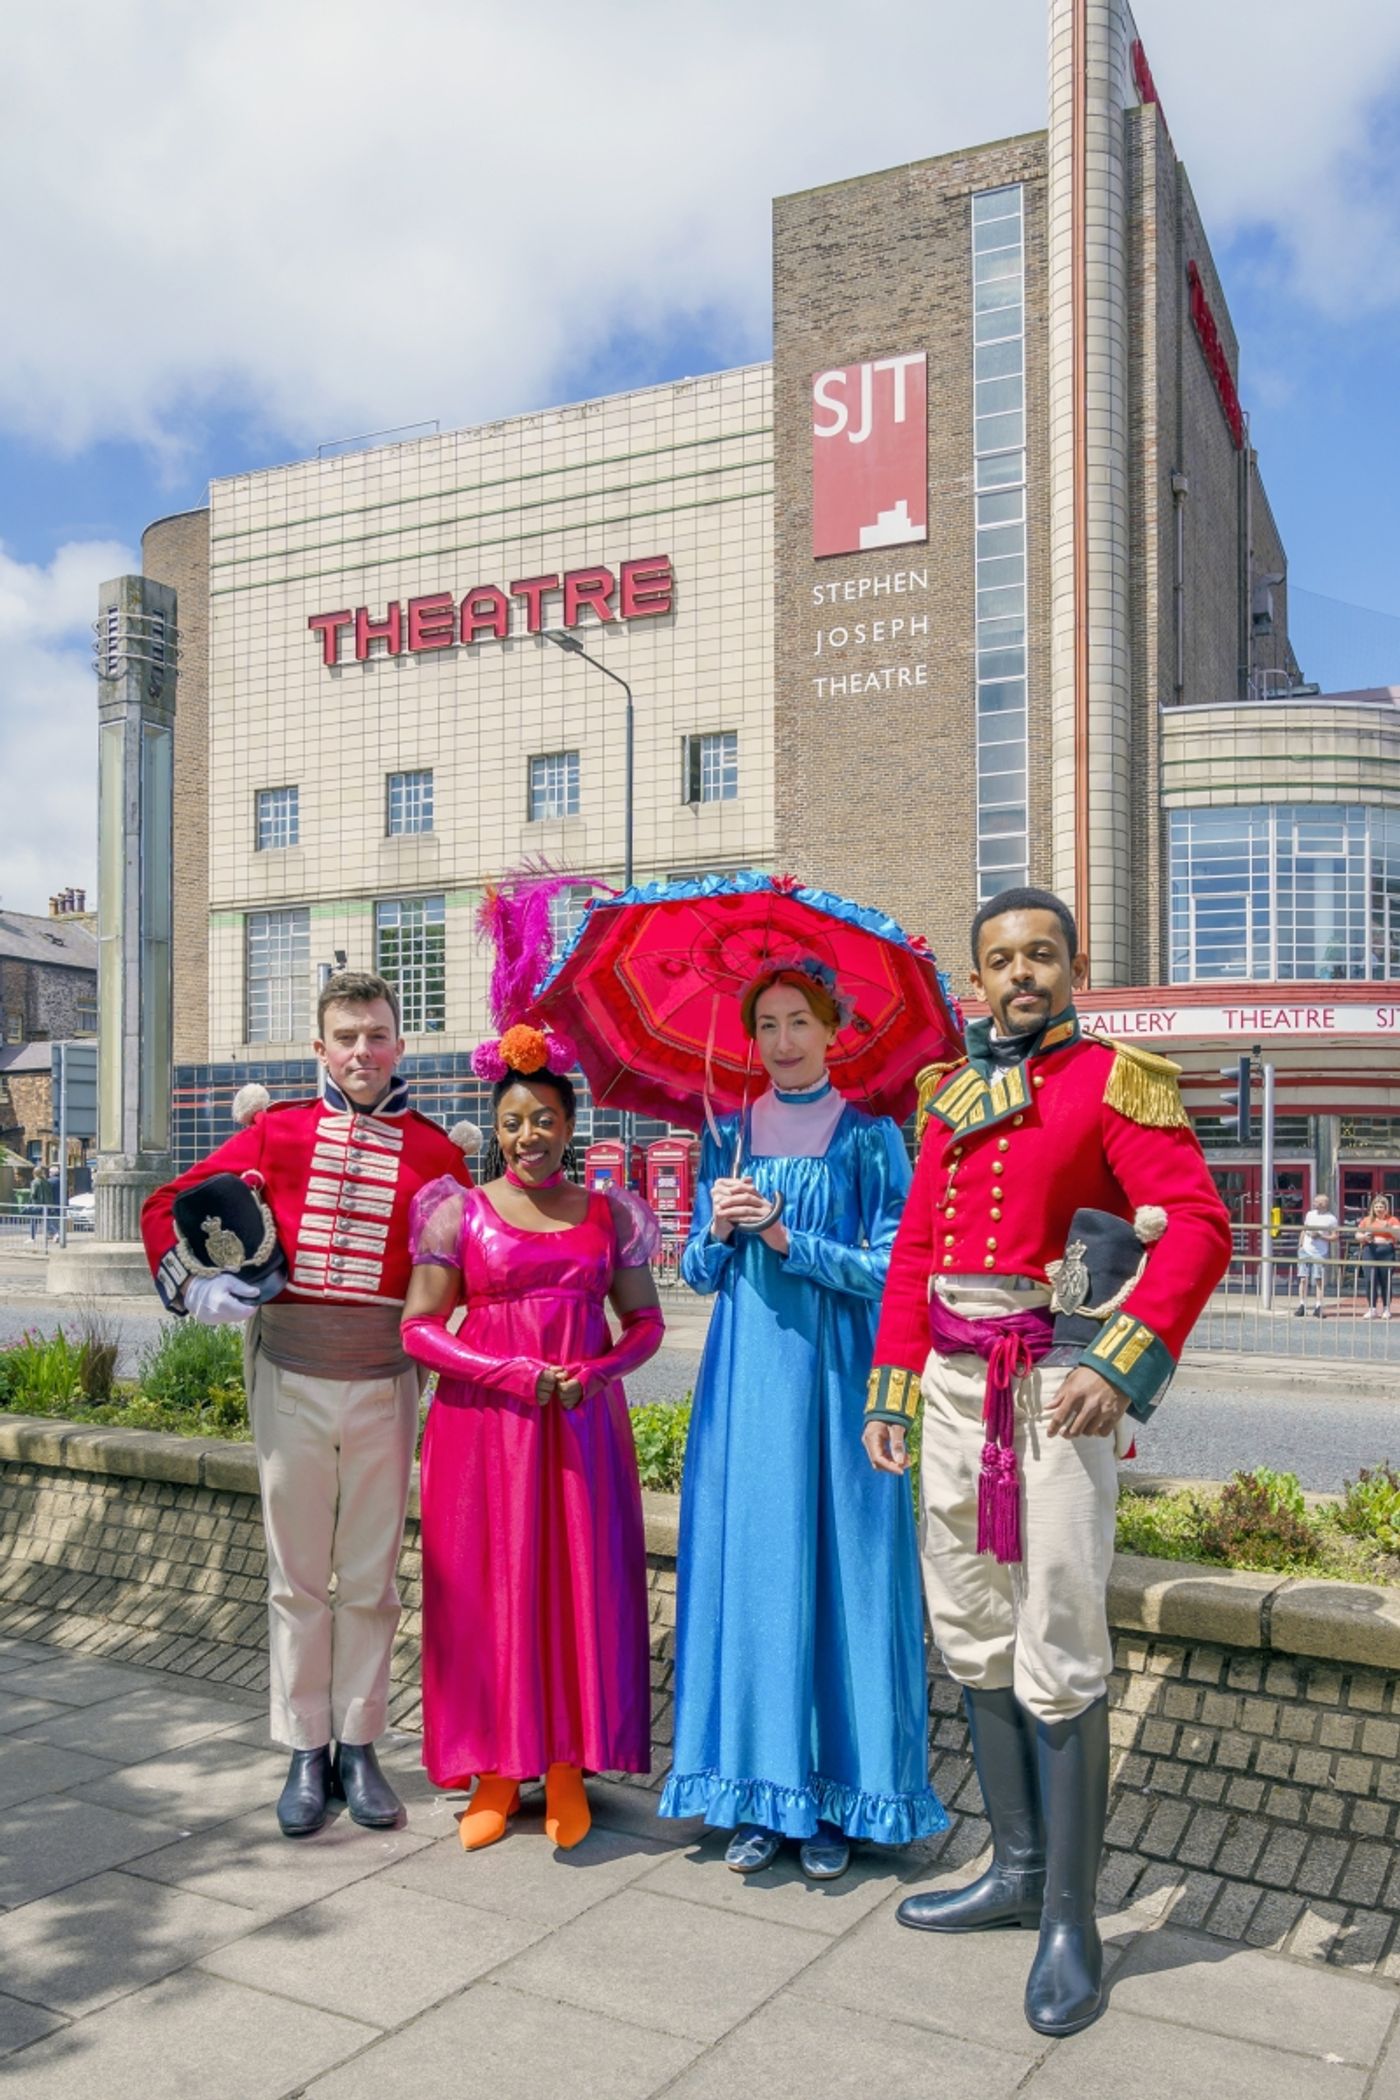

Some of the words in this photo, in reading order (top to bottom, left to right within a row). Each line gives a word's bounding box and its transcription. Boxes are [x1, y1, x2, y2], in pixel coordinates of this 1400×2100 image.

[813, 352, 927, 444] SJT
[812, 569, 929, 606] STEPHEN
[308, 554, 673, 666] THEATRE
[814, 616, 929, 656] JOSEPH
[813, 664, 929, 699] THEATRE
[1222, 1008, 1335, 1029] THEATRE
